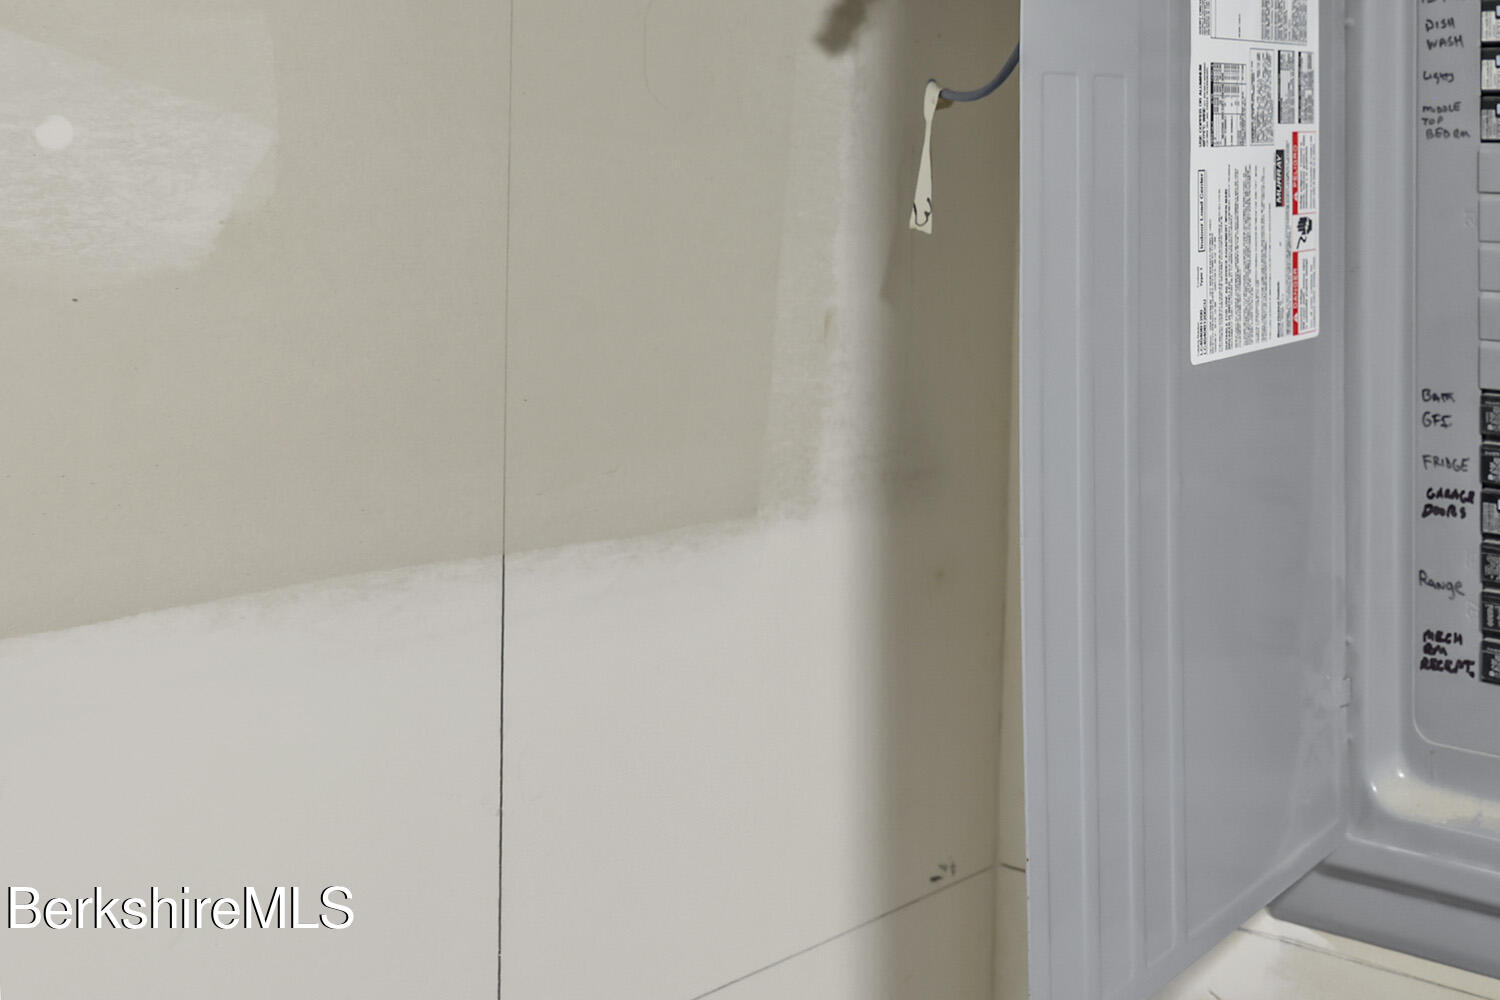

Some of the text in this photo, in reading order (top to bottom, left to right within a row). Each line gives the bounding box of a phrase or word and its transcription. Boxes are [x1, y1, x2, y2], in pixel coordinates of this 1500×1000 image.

[1425, 17, 1456, 32] DISH
[1426, 35, 1464, 51] WASH
[1421, 115, 1444, 126] TOP
[1422, 411, 1452, 429] GFI
[1422, 454, 1470, 473] FRIDGE
[1426, 487, 1476, 505] GARAGE
[1421, 504, 1467, 520] DOORS
[1418, 569, 1465, 601] Range
